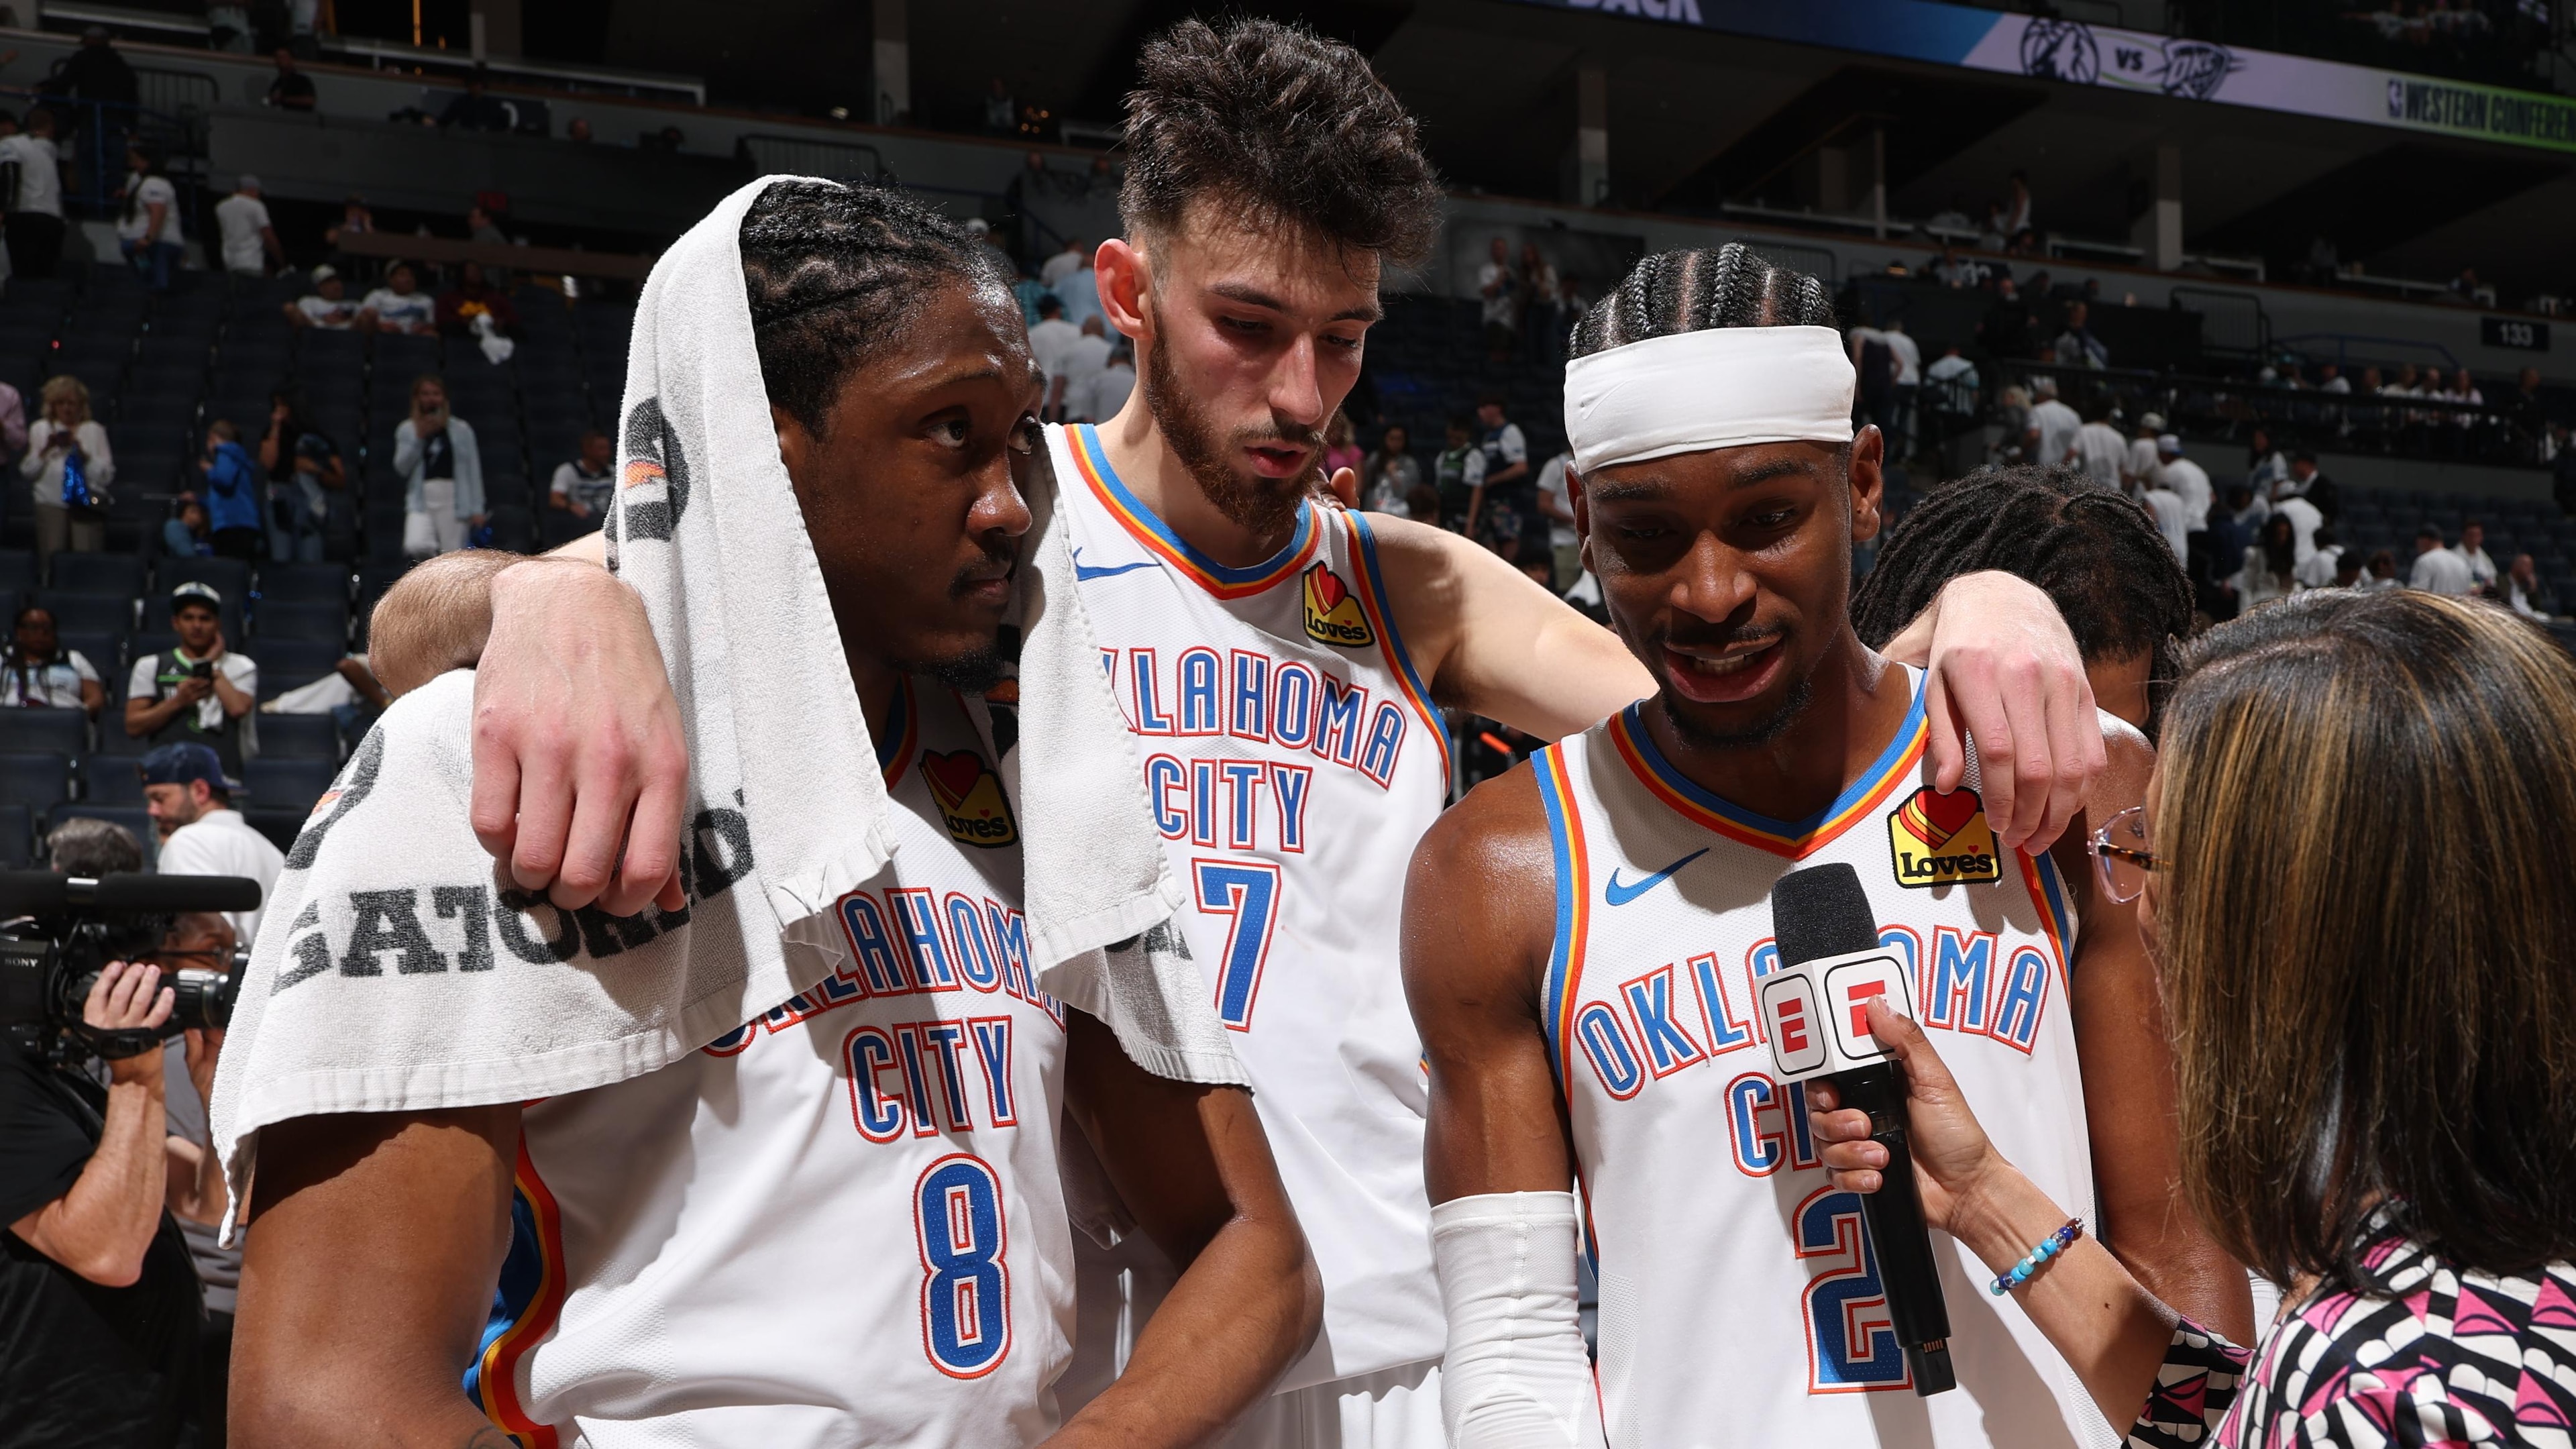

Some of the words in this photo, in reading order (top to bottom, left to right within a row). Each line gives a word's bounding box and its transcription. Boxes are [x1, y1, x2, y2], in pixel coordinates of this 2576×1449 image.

[1567, 0, 1703, 24] CK
[2116, 47, 2143, 72] VS
[2406, 82, 2487, 129] WESTERN
[1100, 646, 1407, 791] LAHOMA
[1144, 753, 1313, 853] CITY
[1191, 857, 1282, 1033] 7
[1574, 924, 2051, 1102] OKLMA
[843, 1014, 1018, 1144] CITY
[1724, 1071, 1823, 1178] CI
[912, 1152, 1013, 1381] 8
[1792, 1185, 1914, 1395] 2
